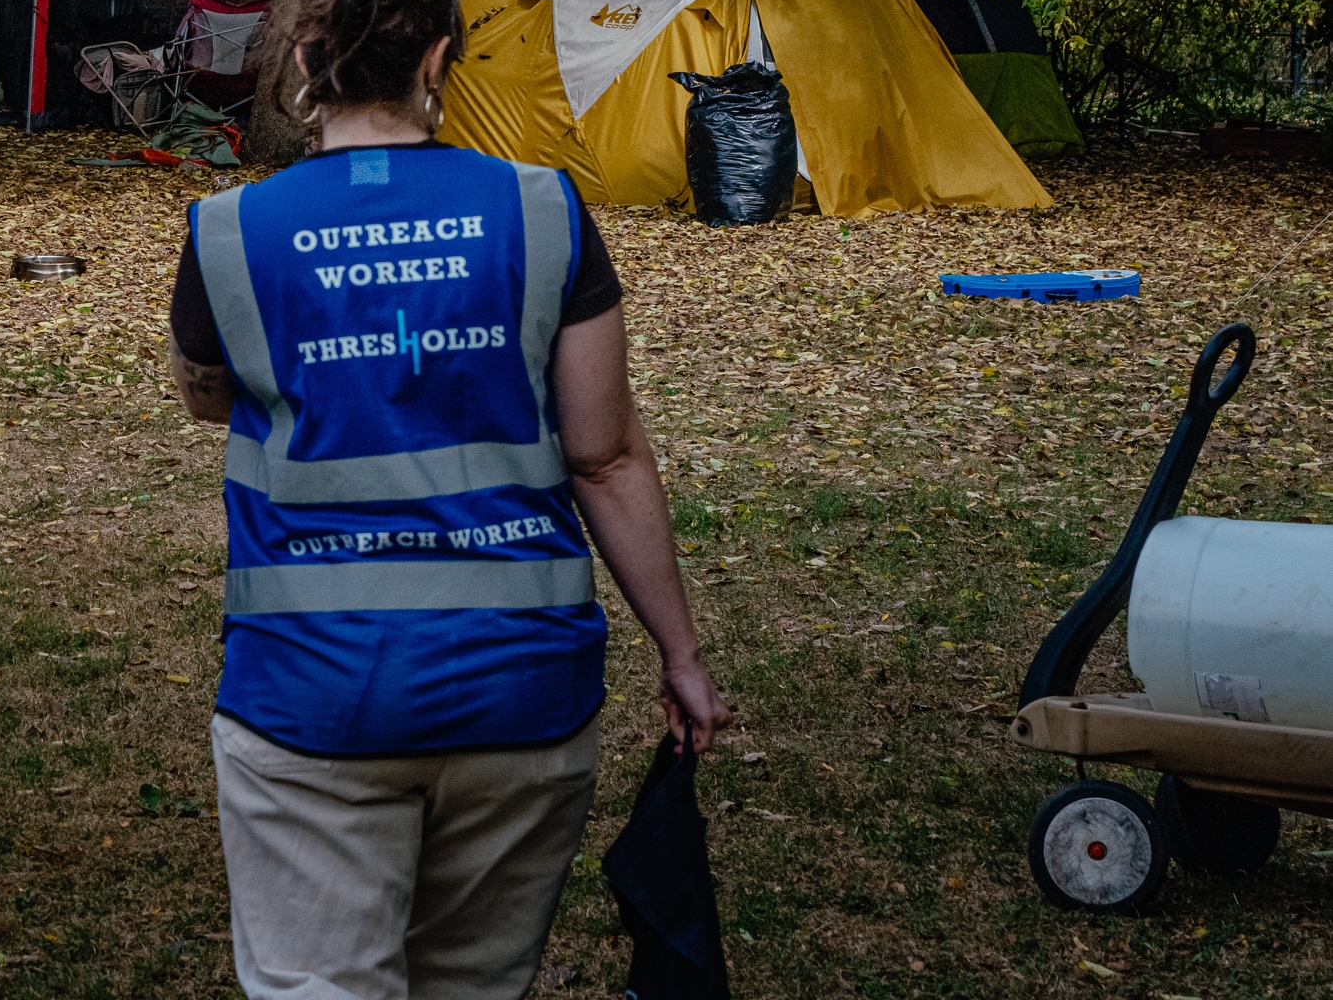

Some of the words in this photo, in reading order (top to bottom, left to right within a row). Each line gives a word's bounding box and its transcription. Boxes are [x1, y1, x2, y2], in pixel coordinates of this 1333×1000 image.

[607, 12, 642, 25] REI
[293, 216, 484, 253] OUTREACH
[315, 255, 470, 290] WORKER
[287, 531, 437, 557] OUTREACH
[446, 514, 557, 550] WORKER
